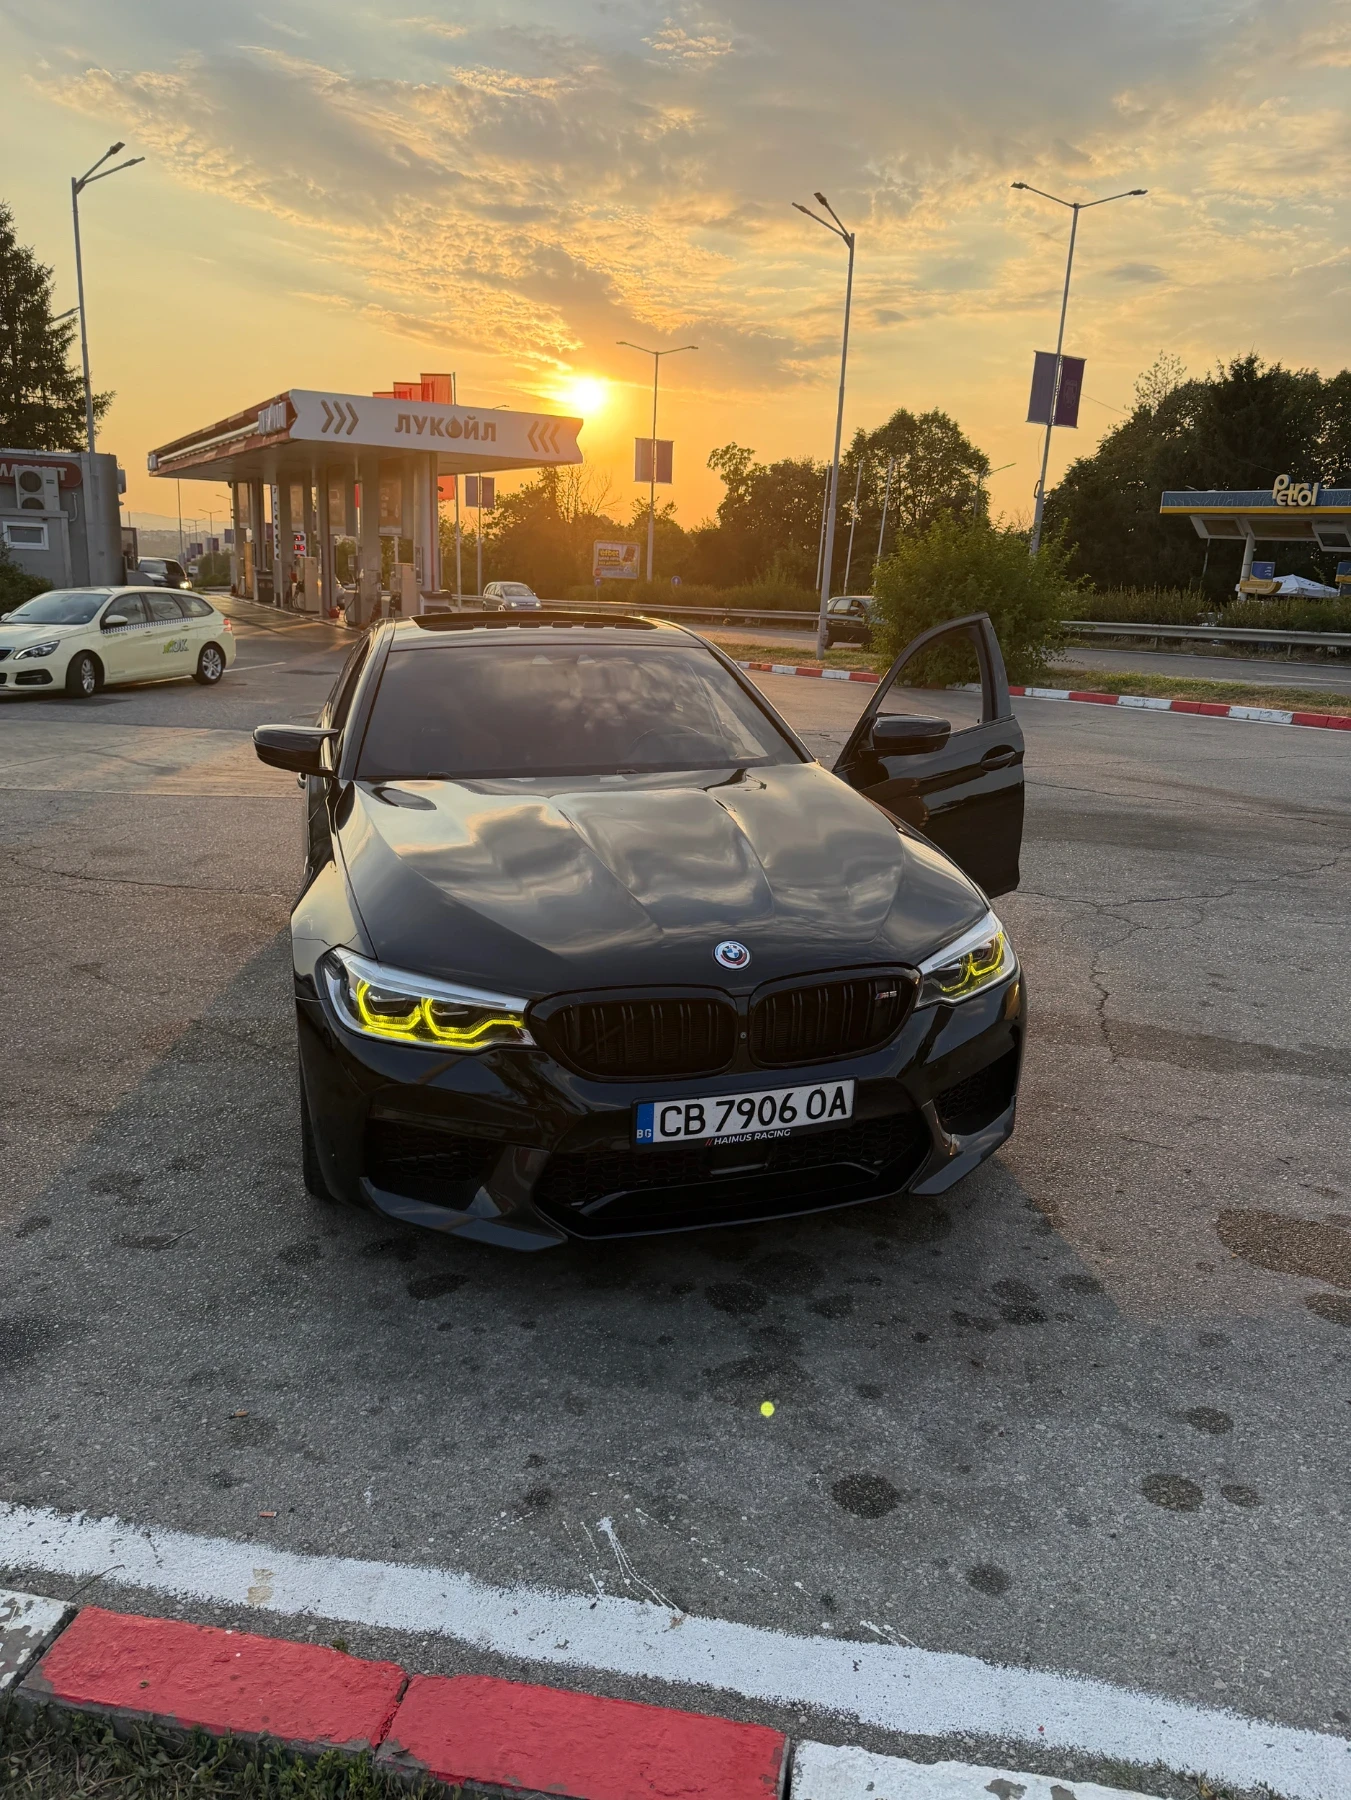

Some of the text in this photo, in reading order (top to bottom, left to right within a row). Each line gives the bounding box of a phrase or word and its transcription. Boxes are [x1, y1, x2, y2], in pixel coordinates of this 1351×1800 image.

[395, 413, 497, 442] ЛУКОЙЛ
[1272, 474, 1320, 507] Petrol
[659, 1085, 848, 1137] CB 7906 OA
[636, 1128, 652, 1139] BG
[754, 1128, 791, 1141] RACING
